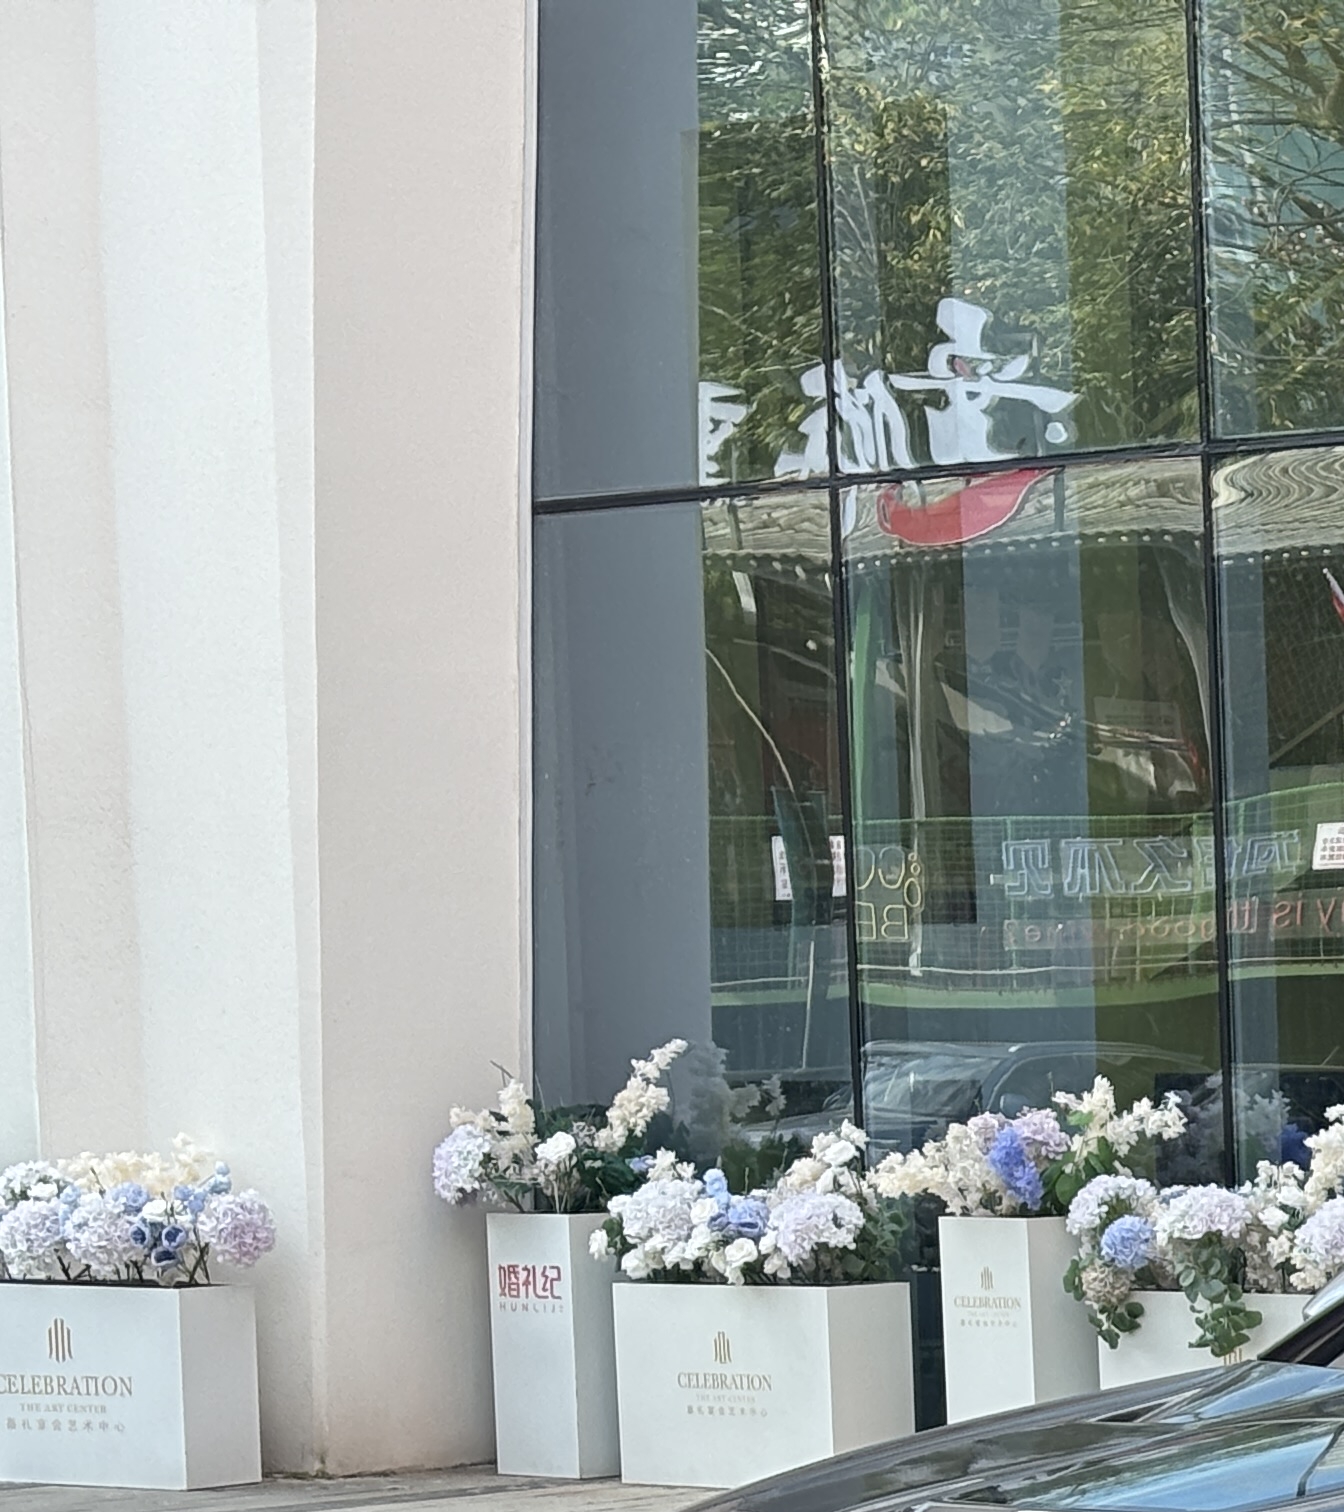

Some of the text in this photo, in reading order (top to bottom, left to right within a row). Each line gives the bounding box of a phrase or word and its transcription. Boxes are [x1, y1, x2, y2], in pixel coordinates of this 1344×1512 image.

[497, 1264, 563, 1300] 婚礼纪
[954, 1296, 1021, 1310] CELEBRATION
[677, 1372, 772, 1391] CELEBRATION
[20, 1402, 42, 1412] THE
[66, 1403, 107, 1414] CENTER
